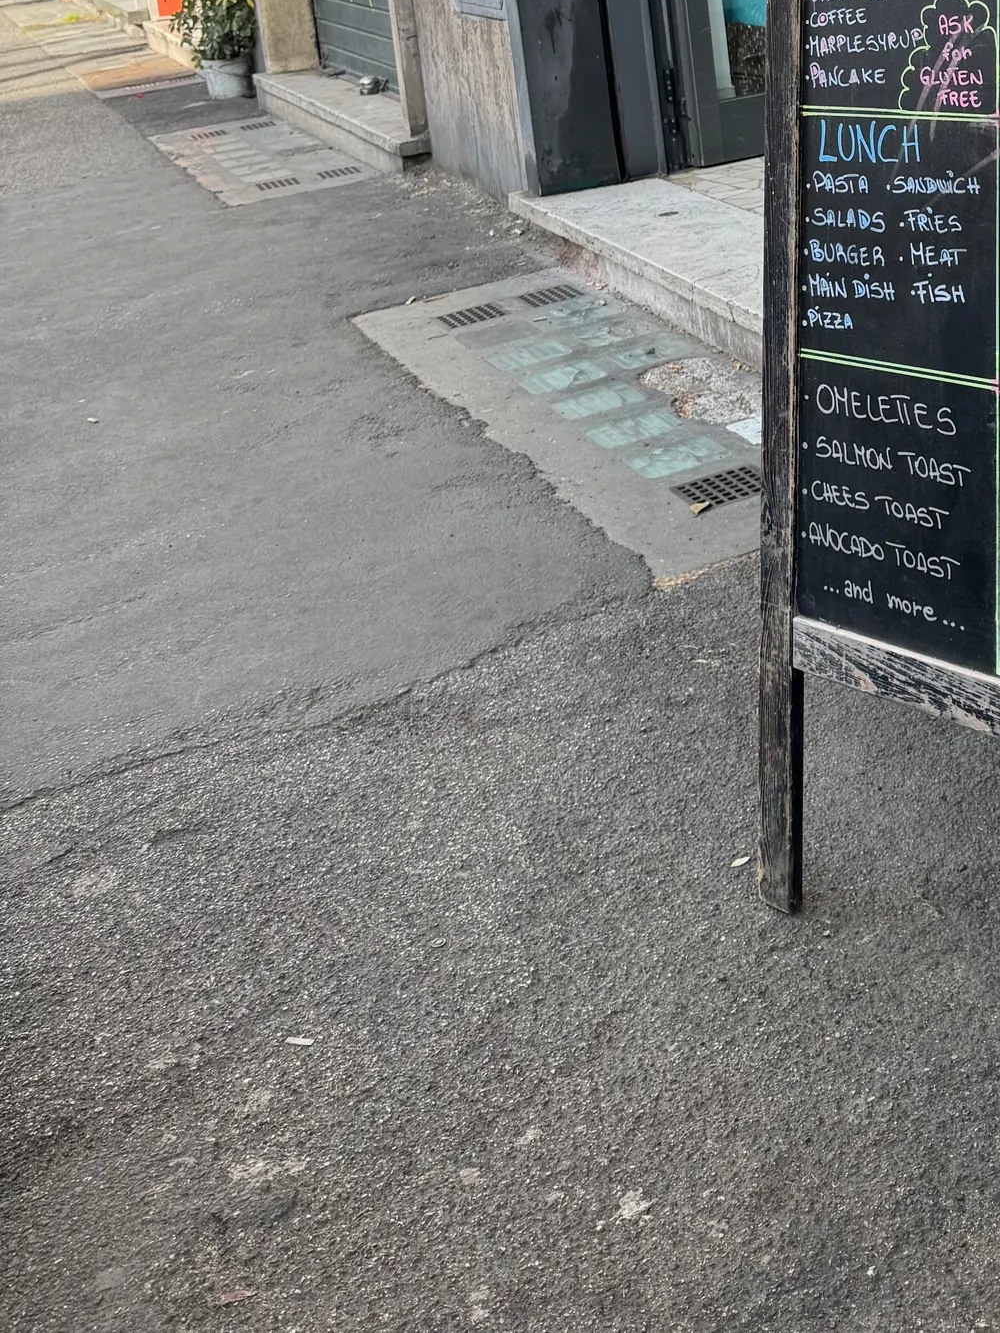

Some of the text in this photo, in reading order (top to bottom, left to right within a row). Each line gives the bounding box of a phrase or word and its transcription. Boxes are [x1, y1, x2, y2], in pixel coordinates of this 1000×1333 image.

[809, 8, 867, 28] COFFEE
[938, 14, 974, 35] ASK
[809, 28, 924, 58] MARPLE SYRUP
[810, 62, 886, 88] PANCAKE
[920, 66, 984, 87] GLUTEN
[938, 89, 982, 108] FREE
[819, 119, 920, 163] LUNCH
[813, 170, 981, 195] PASTA SANDWICH
[811, 207, 963, 234] SALADS FRIES
[809, 239, 967, 267] BURGER MEAT
[808, 271, 966, 304] MAIN DISH FISH
[807, 306, 853, 330] PIZZA
[816, 383, 957, 436] OMELETTES
[815, 436, 972, 487] SALMON TOAST
[811, 480, 950, 530] CHEES TOAST
[809, 521, 961, 580] AVOCADO TOAST
